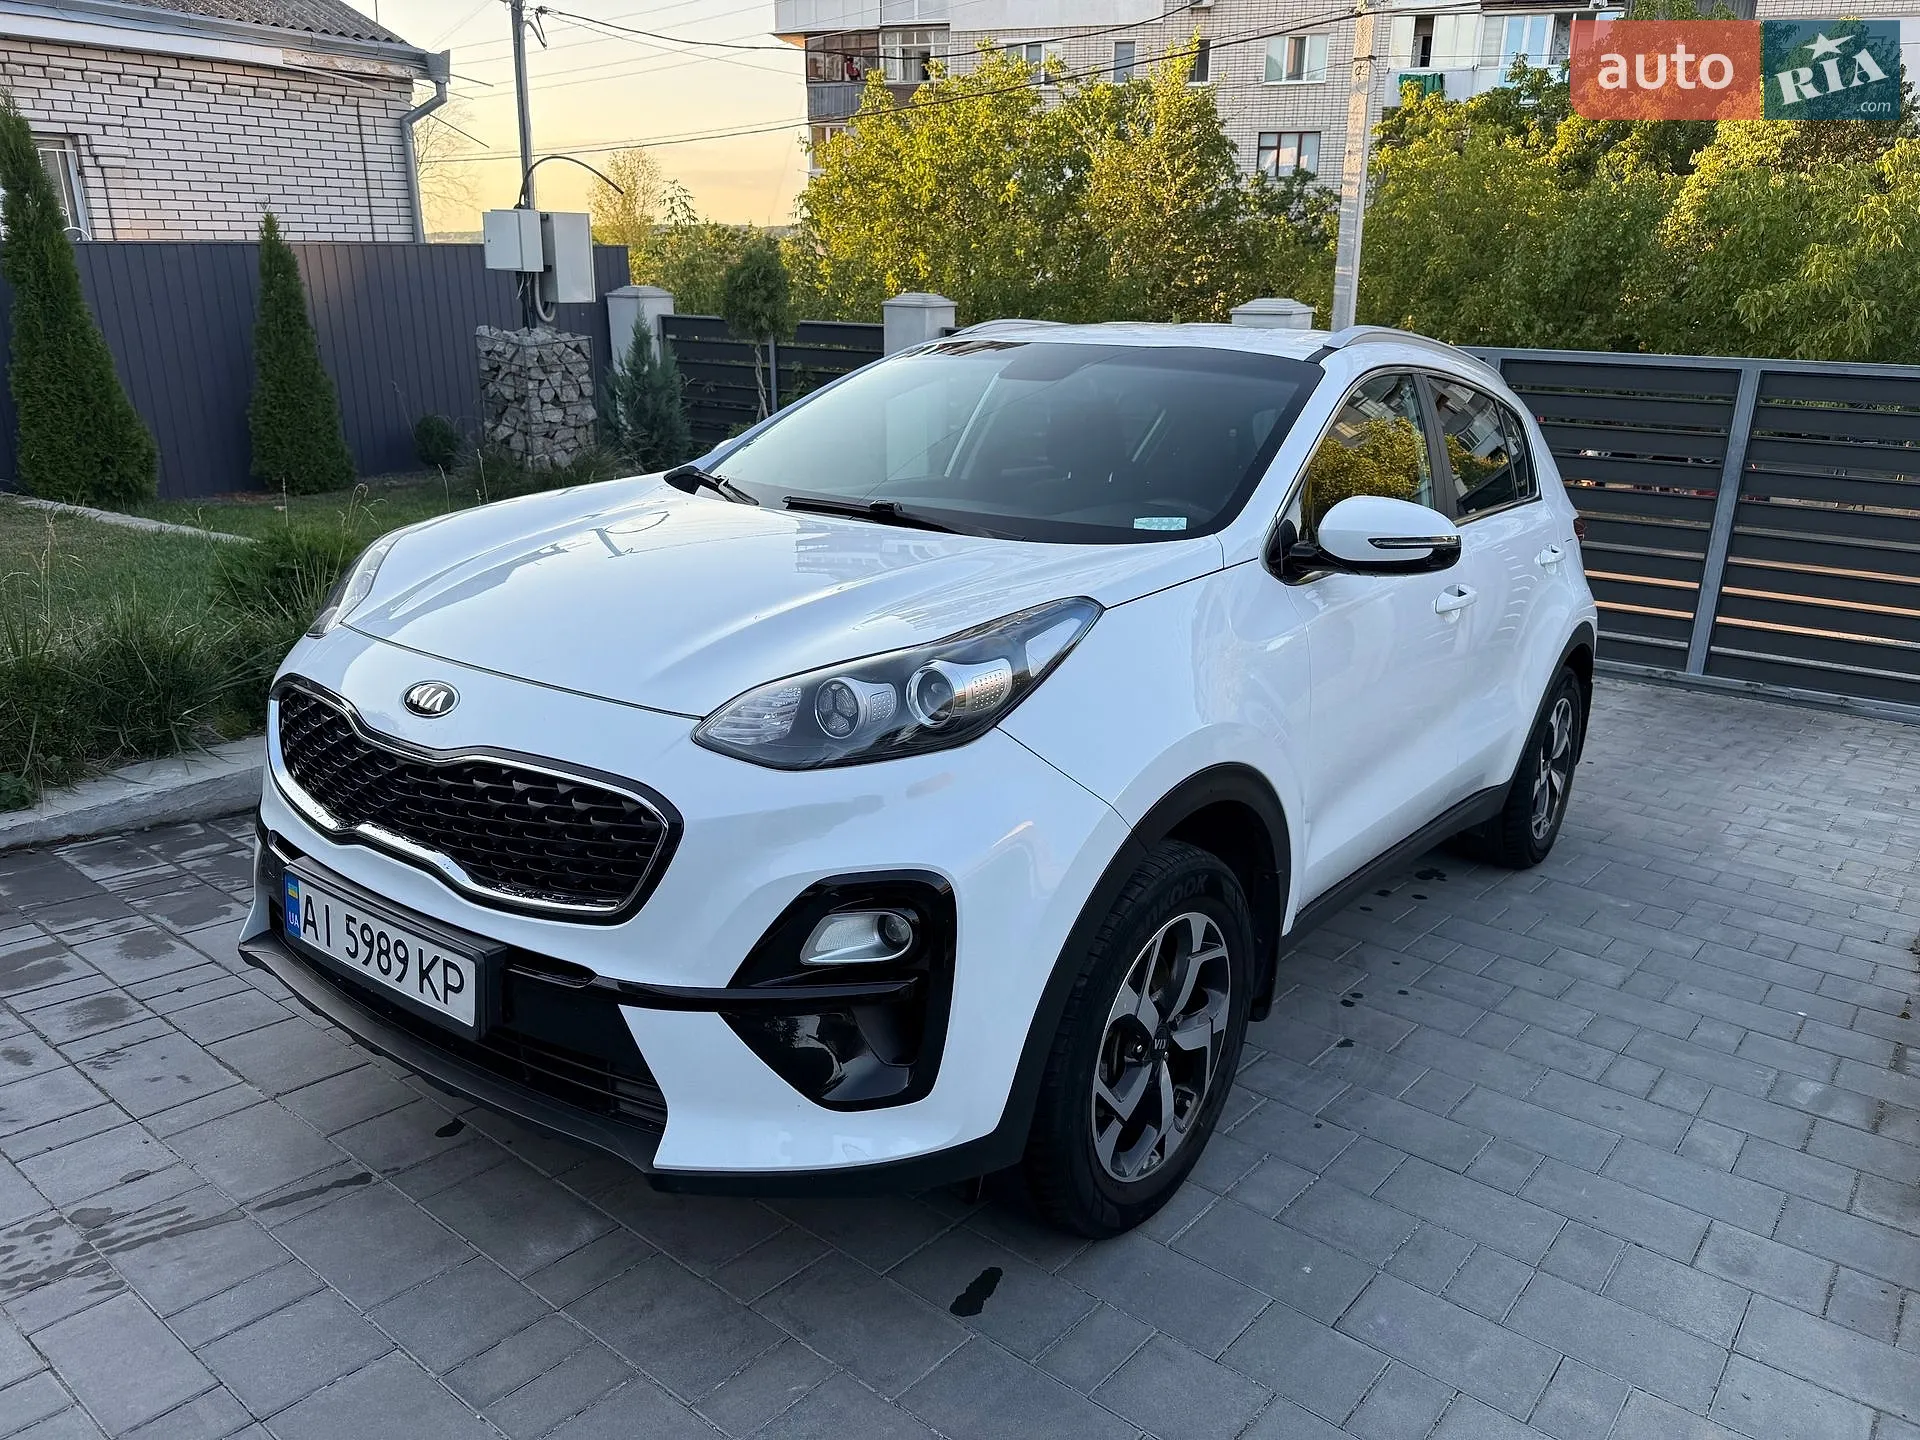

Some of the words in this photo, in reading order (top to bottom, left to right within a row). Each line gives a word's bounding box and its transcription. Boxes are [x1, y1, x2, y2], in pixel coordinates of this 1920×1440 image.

[405, 684, 449, 713] KIA
[288, 911, 300, 929] UA
[302, 894, 331, 948] AI
[345, 913, 409, 984] 5989
[418, 947, 465, 1005] KP
